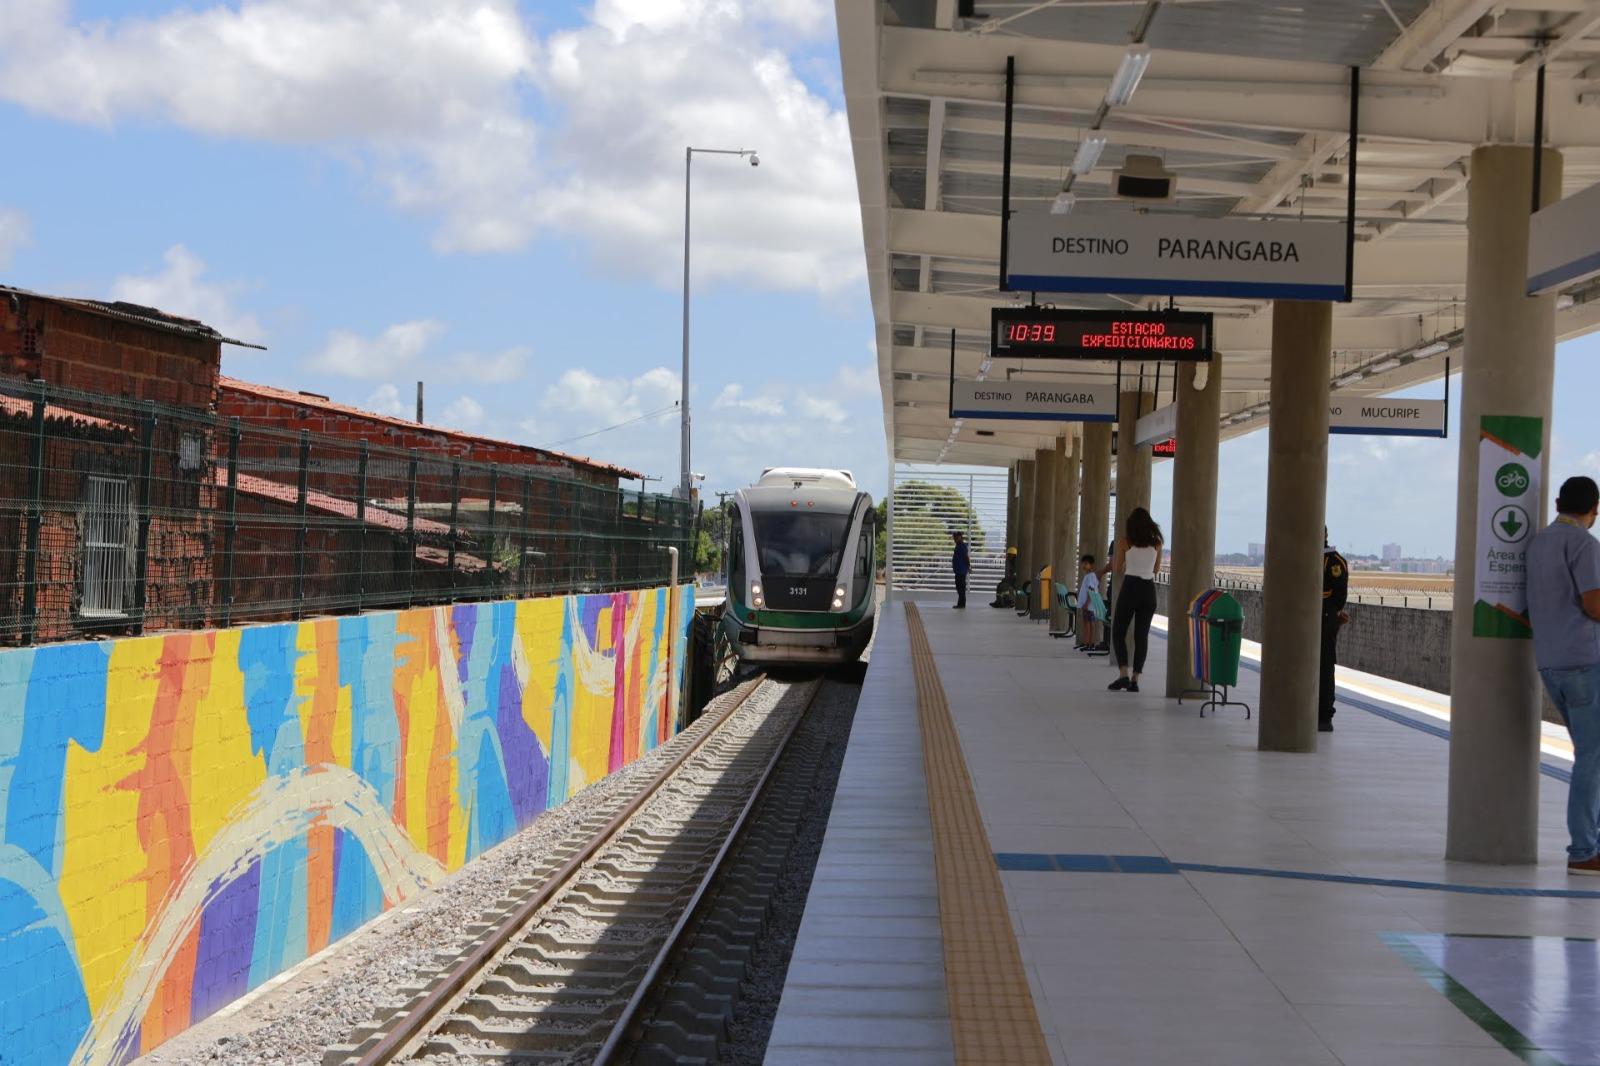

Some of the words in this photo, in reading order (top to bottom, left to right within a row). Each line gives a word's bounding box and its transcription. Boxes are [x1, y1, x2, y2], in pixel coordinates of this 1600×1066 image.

[1052, 237, 1129, 255] DESTINO
[1158, 238, 1299, 262] PARANGABA
[1010, 325, 1055, 341] 10:39
[974, 391, 1012, 401] DESTINO
[1026, 392, 1095, 404] PARANGABA
[1329, 407, 1342, 416] NO
[1361, 407, 1420, 419] MUCURIPE
[1487, 546, 1515, 560] Área
[1489, 560, 1527, 574] Esper
[789, 587, 807, 595] 3131
